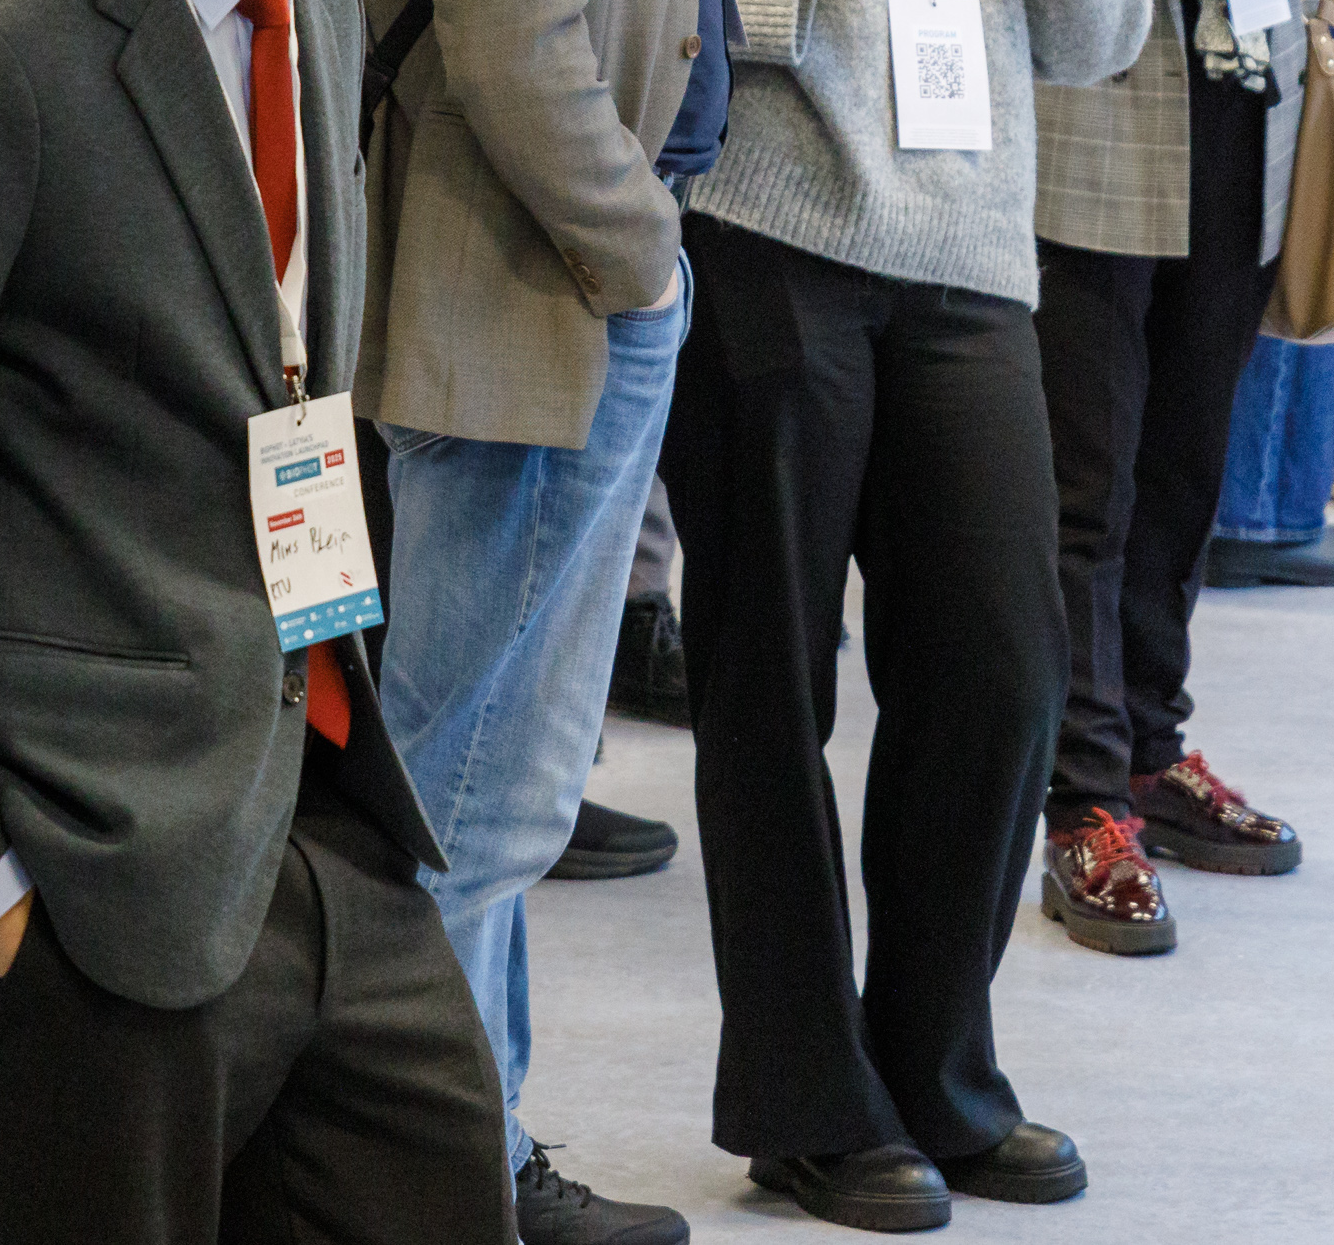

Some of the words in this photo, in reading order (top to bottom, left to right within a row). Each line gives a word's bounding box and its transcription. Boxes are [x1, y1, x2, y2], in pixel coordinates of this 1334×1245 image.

[918, 29, 957, 39] PROGRAM
[326, 452, 343, 465] 2025
[293, 476, 345, 498] CONFERENCE
[270, 577, 292, 601] RTU
